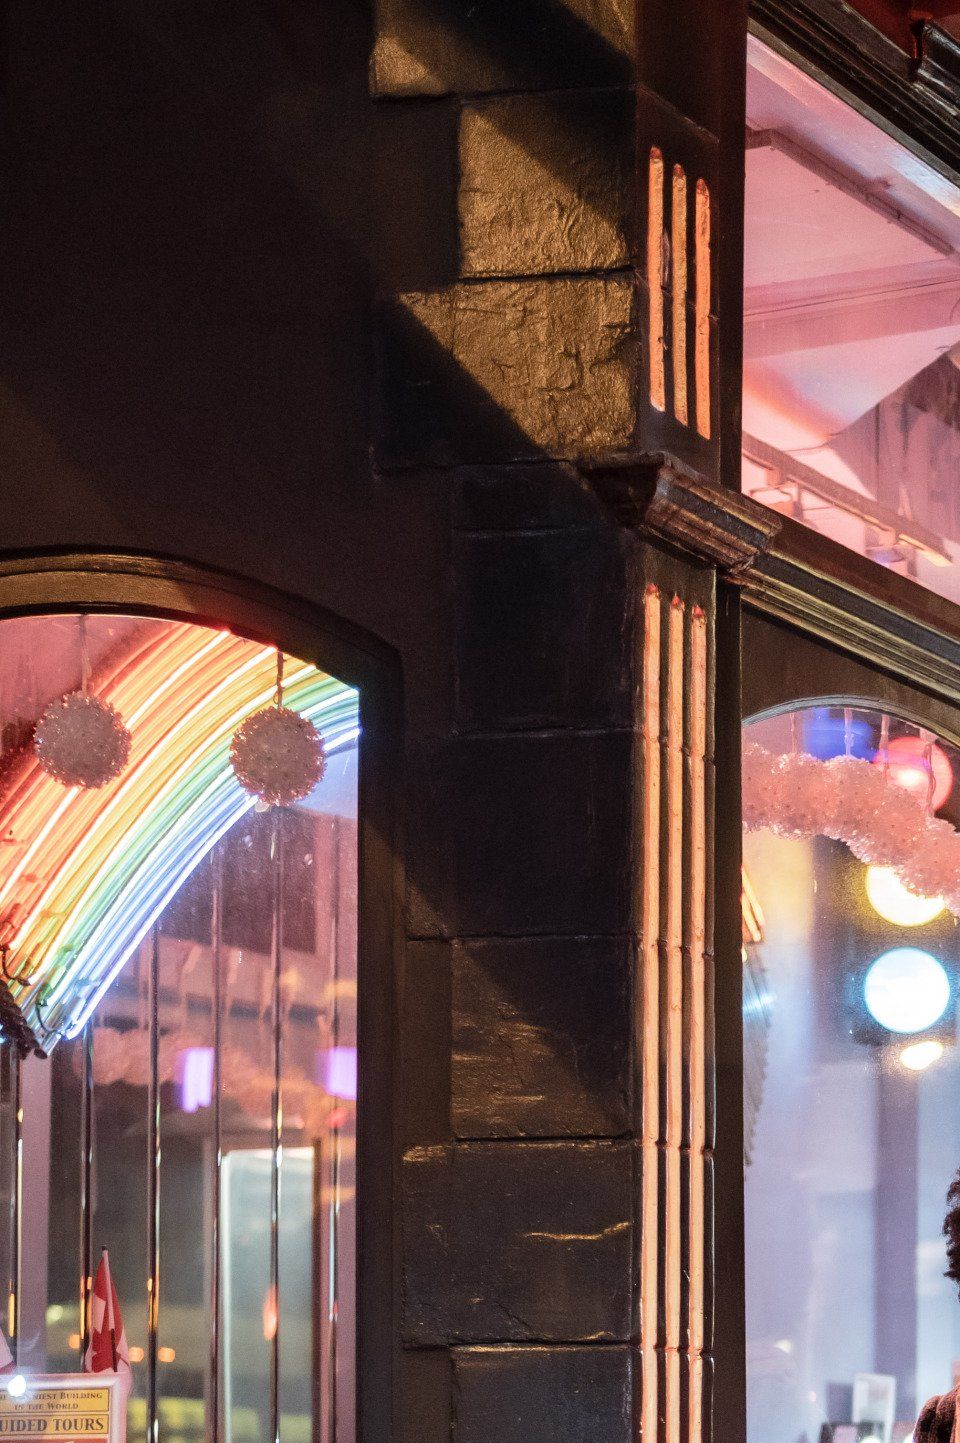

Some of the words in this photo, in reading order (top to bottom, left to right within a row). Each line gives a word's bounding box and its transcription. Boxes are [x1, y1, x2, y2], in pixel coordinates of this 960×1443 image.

[47, 1402, 79, 1411] WORLD
[0, 1418, 48, 1433] UIDED
[53, 1417, 105, 1432] TOURS
